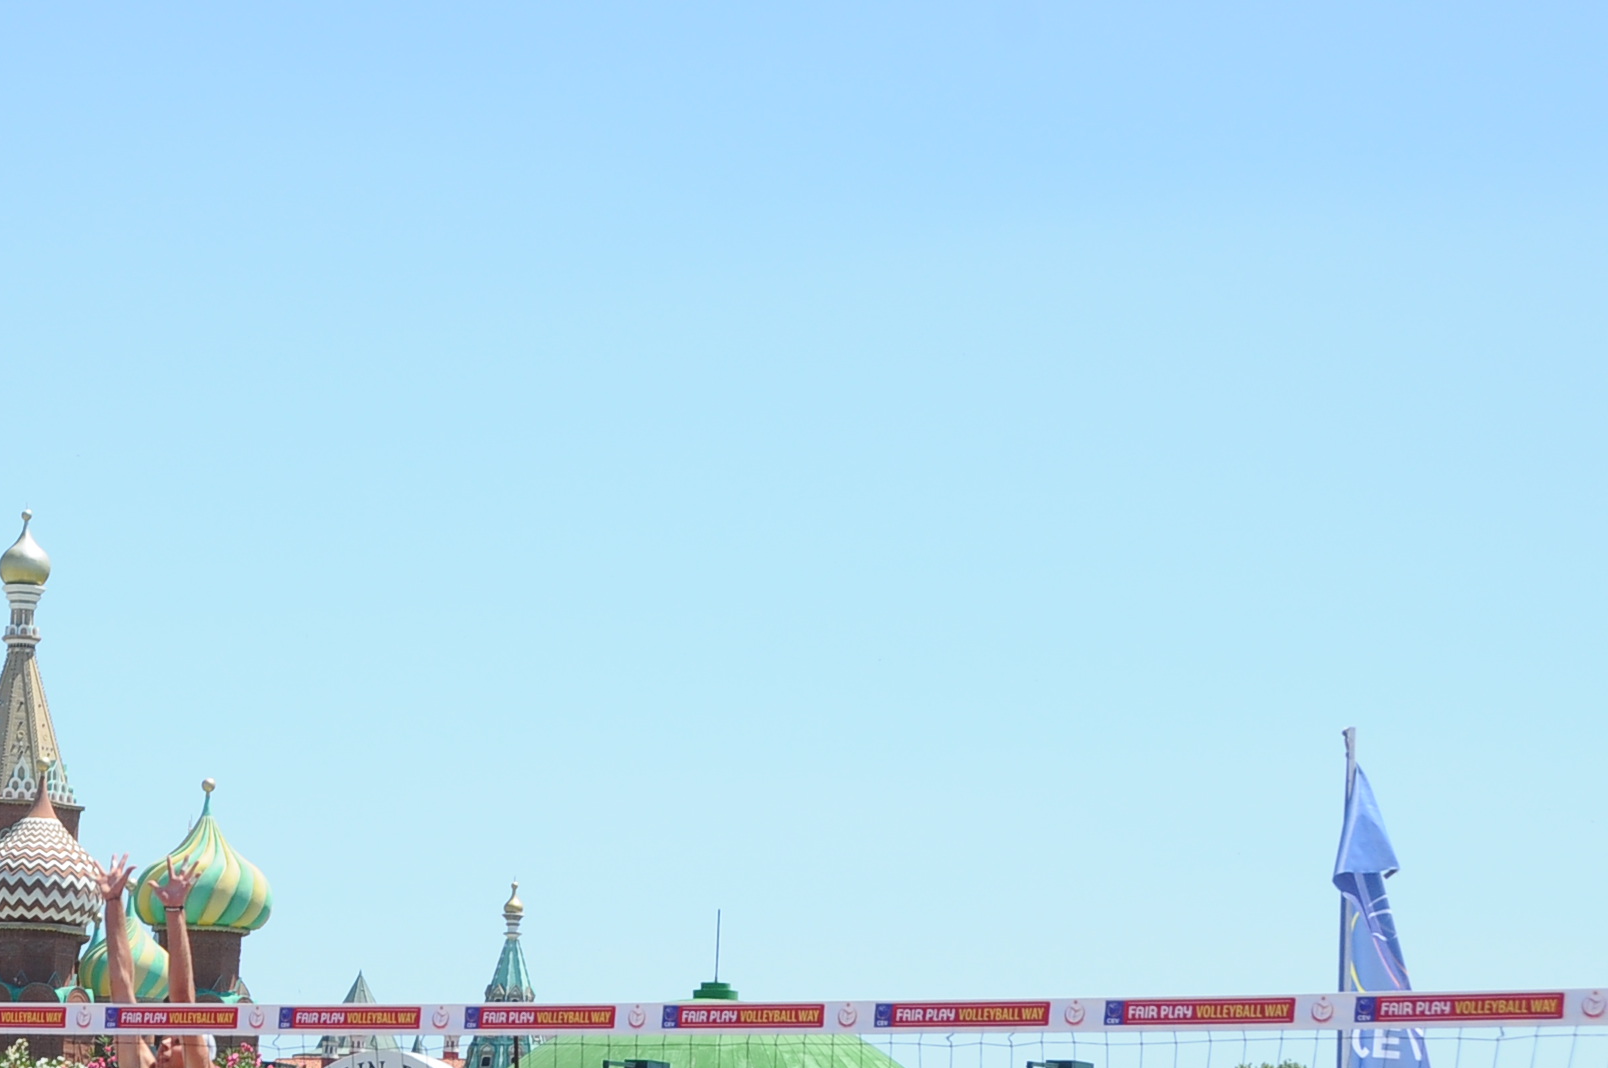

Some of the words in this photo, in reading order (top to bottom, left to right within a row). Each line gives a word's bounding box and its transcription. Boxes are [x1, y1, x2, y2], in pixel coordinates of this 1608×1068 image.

[1128, 1006, 1157, 1019] FAIR
[1160, 1006, 1192, 1018] PLAY
[1196, 1005, 1262, 1018] VOLLEYBALL
[1265, 1004, 1289, 1016] WAY
[1380, 1002, 1413, 1016] FAIR
[1416, 1001, 1450, 1015] PLAY
[1454, 1000, 1528, 1014] VOLLEYBALL
[1530, 999, 1558, 1012] WAY
[1, 1012, 44, 1023] VOLLEYBALL
[46, 1012, 62, 1023] WAY
[121, 1012, 142, 1024] FAIR
[144, 1012, 167, 1024] PLAY
[169, 1012, 215, 1024] VOLLEYBALL
[217, 1012, 235, 1024] WAY
[296, 1012, 318, 1024] FAIR
[320, 1012, 345, 1024] PLAY
[347, 1012, 396, 1024] VOLLEYBALL
[398, 1012, 417, 1024] WAY
[482, 1012, 507, 1024] FAIR
[509, 1012, 534, 1023] PLAY
[537, 1012, 588, 1023] VOLLEYBALL
[591, 1012, 611, 1023] WAY
[681, 1011, 708, 1022] FAIR
[710, 1010, 737, 1022] PLAY
[740, 1010, 796, 1022] VOLLEYBALL
[799, 1010, 820, 1022] WAY
[895, 1009, 923, 1022] FAIR
[925, 1008, 955, 1021] PLAY
[958, 1008, 1020, 1021] VOLLEYBALL
[1022, 1008, 1044, 1020] WAY
